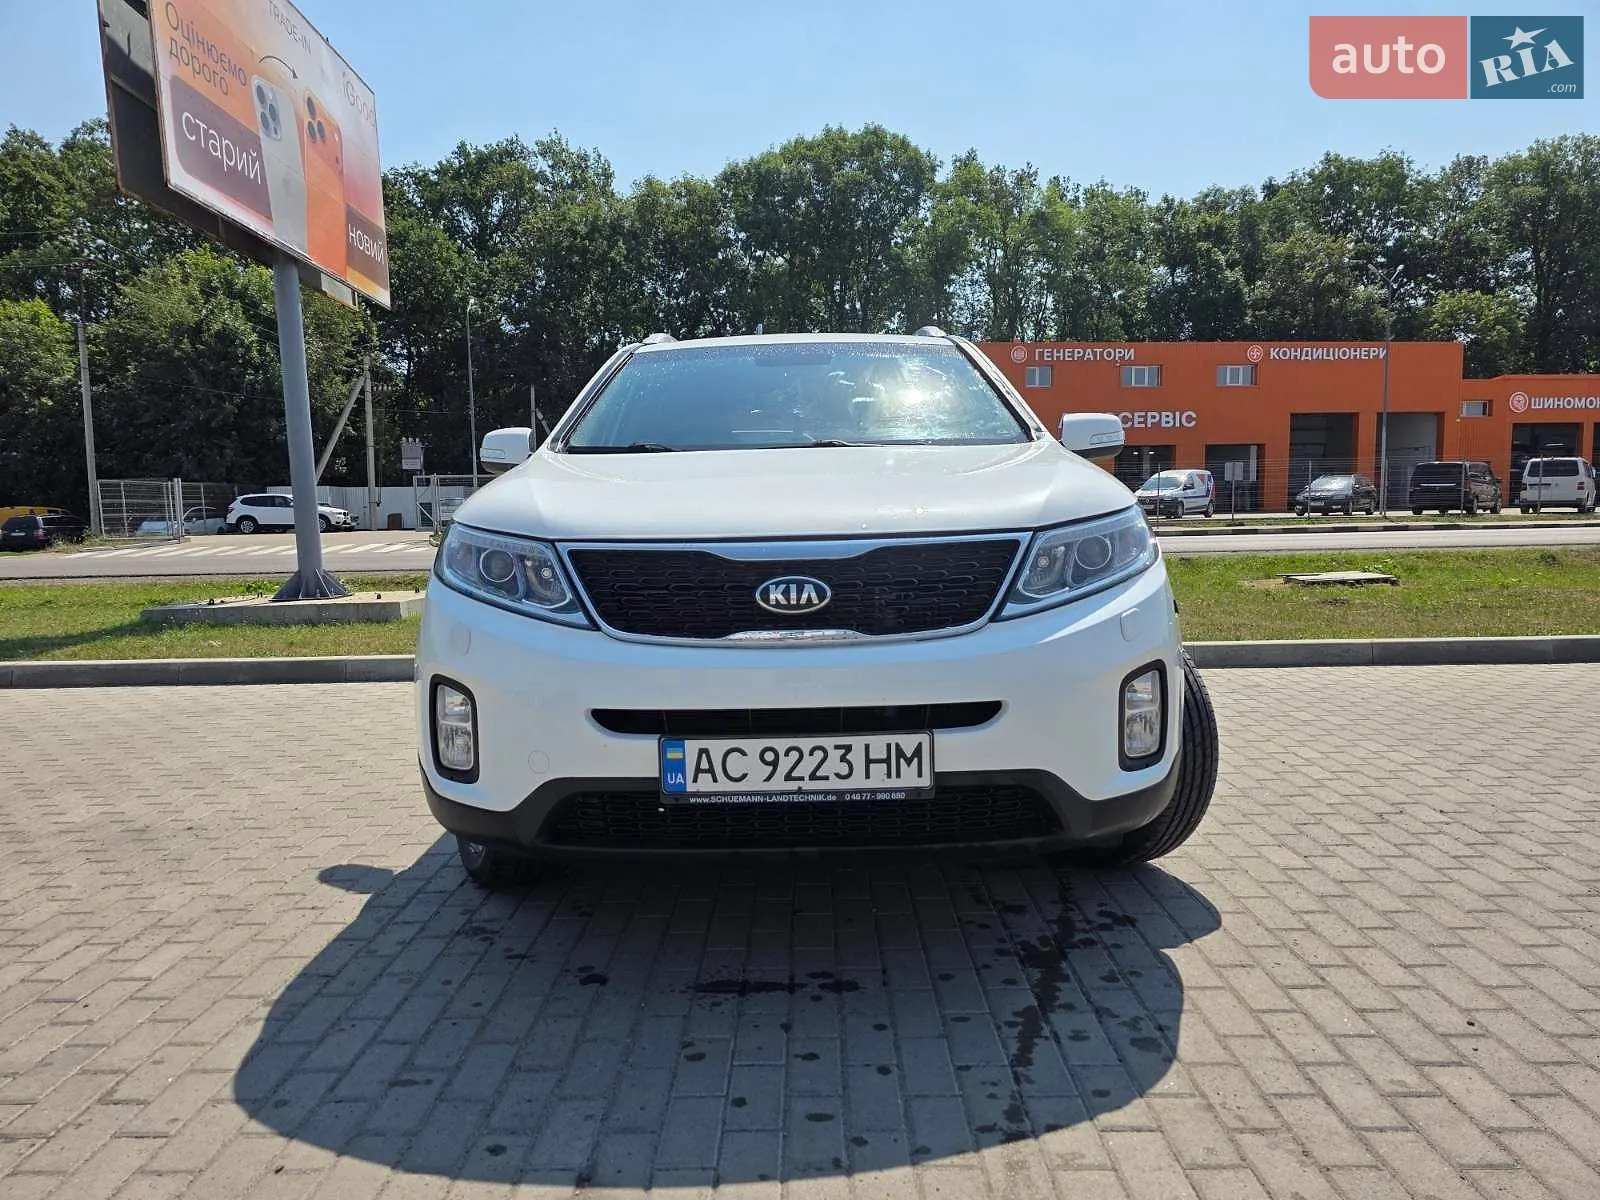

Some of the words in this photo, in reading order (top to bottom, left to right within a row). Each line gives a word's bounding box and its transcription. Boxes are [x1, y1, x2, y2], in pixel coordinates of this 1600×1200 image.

[165, 1, 248, 87] Оцінюємо
[169, 37, 230, 96] дорого
[182, 112, 262, 185] старий
[349, 224, 385, 265] новий
[1035, 348, 1135, 361] ГЕНЕРАТОРИ
[1269, 347, 1387, 360] КОНДИЦІОНЕРИ
[768, 583, 820, 605] KIA
[667, 773, 685, 784] UA
[691, 747, 749, 783] AC
[758, 744, 855, 782] 9223
[864, 741, 923, 780] HM
